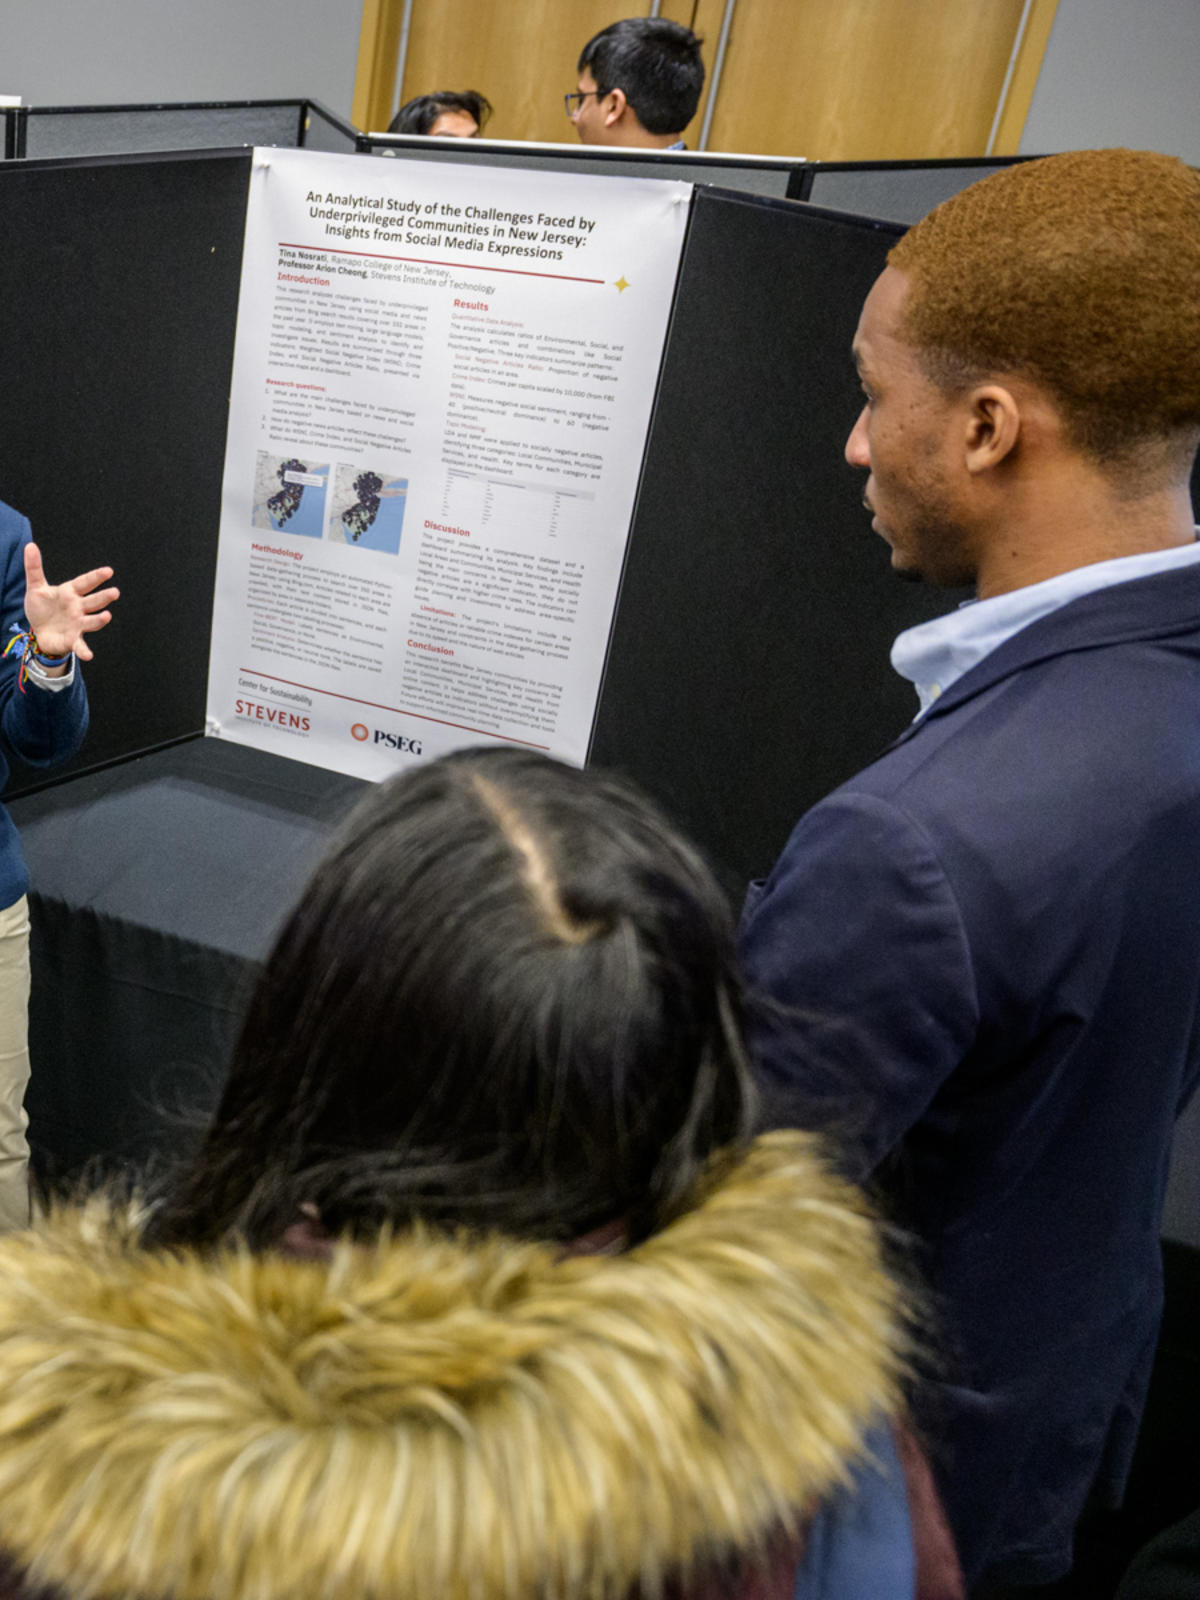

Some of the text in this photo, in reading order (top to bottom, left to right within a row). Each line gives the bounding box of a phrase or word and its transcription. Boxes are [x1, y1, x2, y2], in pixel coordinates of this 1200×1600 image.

[306, 191, 596, 232] An Analytical Study of the Challenges Faced by
[310, 208, 587, 247] Underprivileged Communities in New Jersey:
[325, 224, 563, 259] Insights from Social Media Expressions
[278, 259, 496, 295] Professor Arion Cheong, Stevens Institute of Technology
[280, 249, 453, 279] Tina Nosrati, Ramapo College of New Jersey,
[277, 272, 330, 286] Introduction
[453, 299, 488, 311] Results
[424, 520, 470, 536] Discussion
[251, 544, 304, 560] Methodology
[407, 640, 454, 655] Conclusion
[238, 678, 312, 706] Center for Sustainability
[236, 700, 310, 730] STEVENS
[374, 731, 423, 754] PSEG
